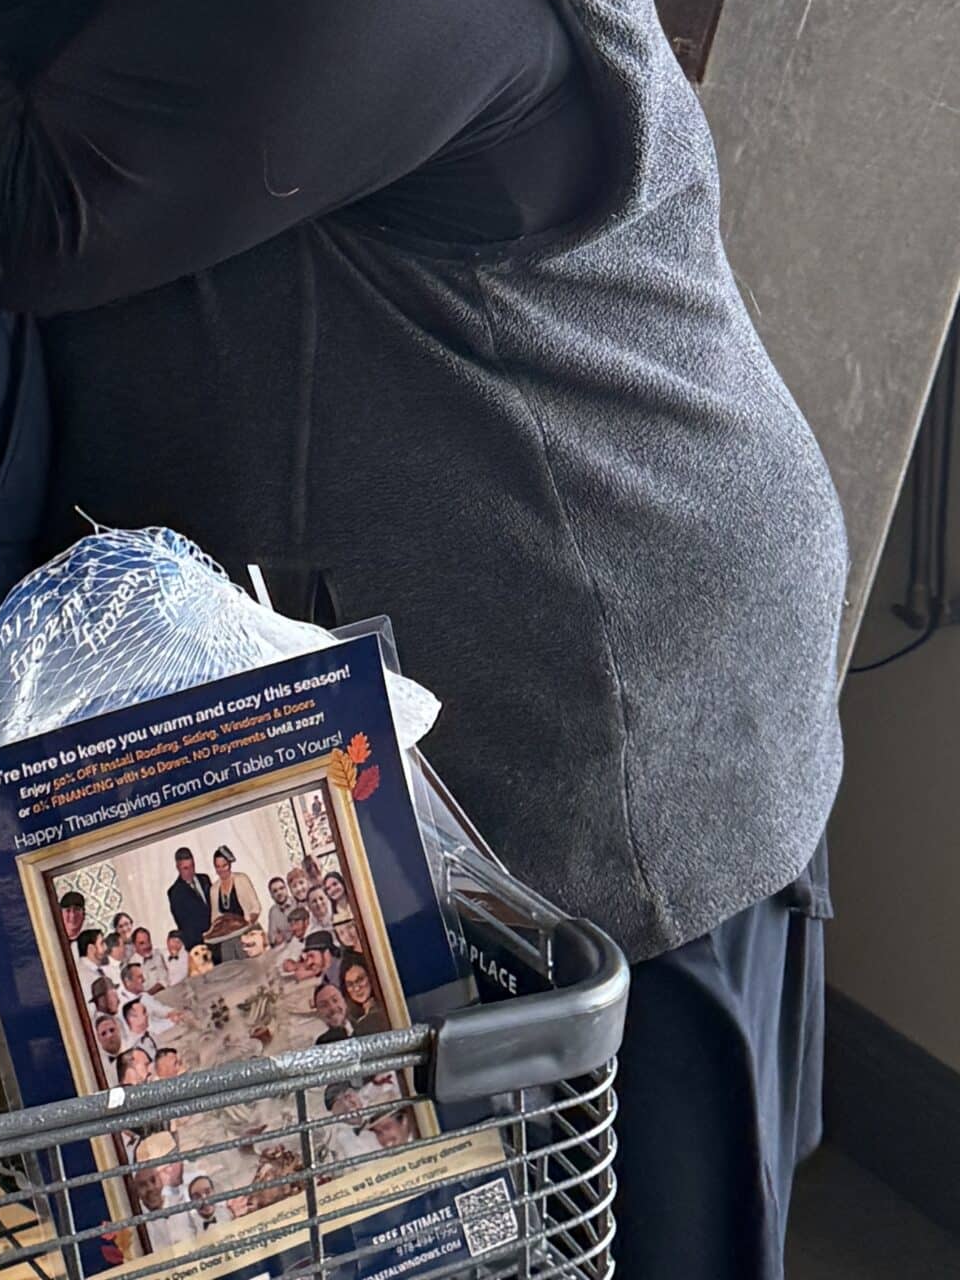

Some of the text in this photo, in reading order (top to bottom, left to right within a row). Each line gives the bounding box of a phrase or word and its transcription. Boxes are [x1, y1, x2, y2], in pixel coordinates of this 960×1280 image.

[19, 781, 52, 801] Enjoy
[76, 765, 99, 781] OFF
[100, 753, 136, 774] Install
[220, 711, 272, 735] Windows
[272, 706, 283, 719] &
[283, 699, 317, 717] Doors
[22, 755, 58, 779] here
[59, 750, 77, 766] to
[77, 736, 118, 761] keep
[118, 728, 148, 749] you
[149, 712, 194, 737] warm
[195, 701, 225, 724] and
[227, 692, 263, 714] cozy
[263, 683, 292, 703] this
[293, 664, 352, 694] season!
[14, 731, 344, 850] Happy Thanksgiving From Our Table To Yours!
[18, 807, 31, 820] or
[51, 778, 115, 809] FINANCING
[115, 769, 140, 788] with
[212, 731, 268, 757] Payments
[267, 723, 295, 740] Until
[470, 944, 518, 995] PLACE
[407, 1154, 439, 1172] turkey
[399, 1205, 454, 1236] ESTIMATE
